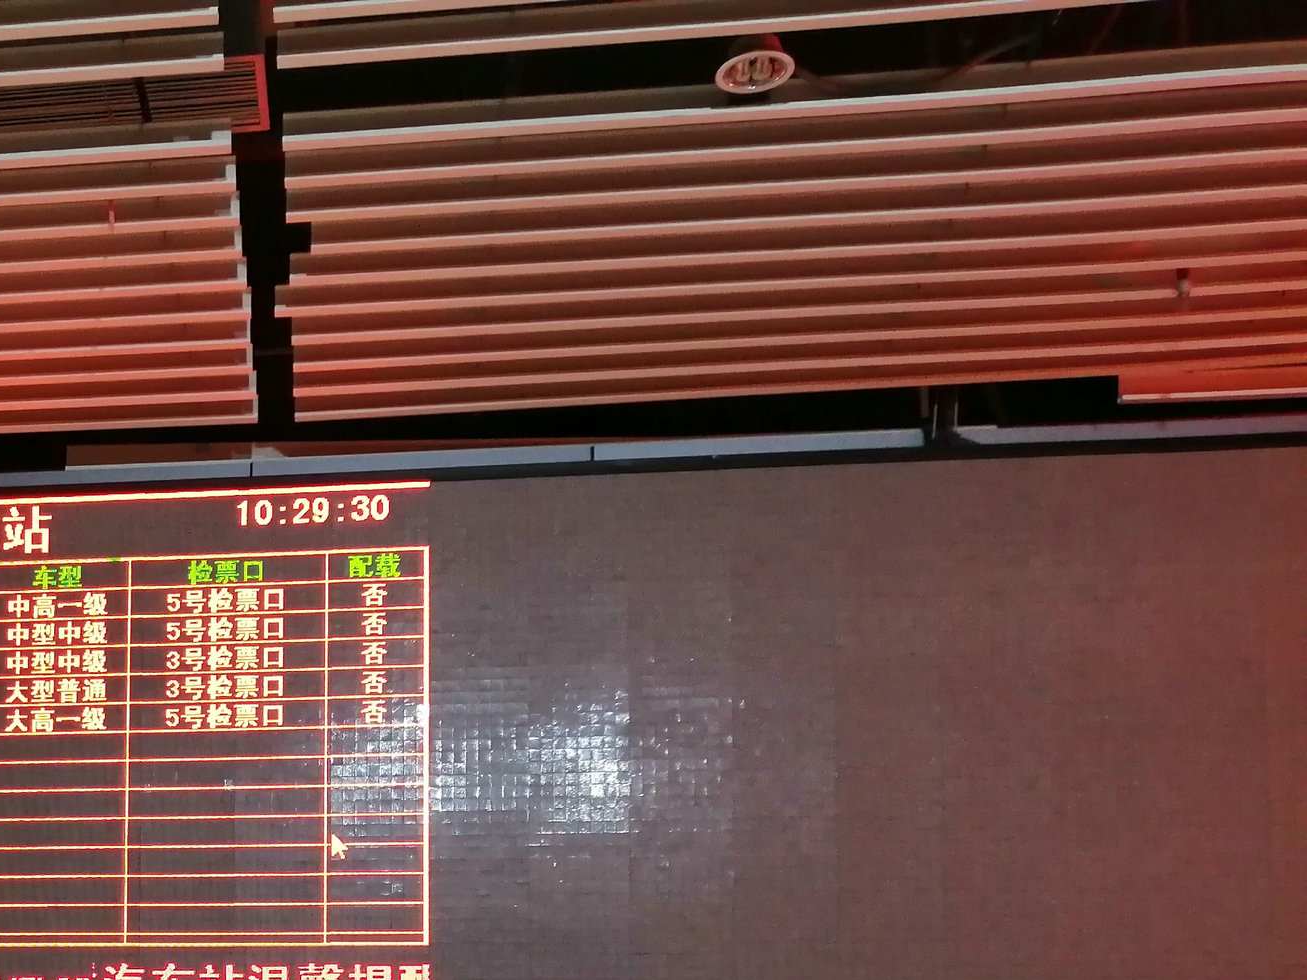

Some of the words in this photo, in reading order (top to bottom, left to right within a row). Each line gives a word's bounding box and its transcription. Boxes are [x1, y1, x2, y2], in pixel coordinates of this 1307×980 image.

[237, 495, 390, 526] 10:29:30
[34, 566, 82, 589] 车型
[188, 560, 264, 585] 检票口
[348, 553, 401, 579] 配载
[8, 592, 107, 618] 中高一级
[167, 588, 284, 614] 5号检票口
[362, 584, 387, 607] 否
[8, 621, 107, 646] 中型中级
[166, 617, 284, 642] 5号检票口
[361, 613, 387, 636] 否
[8, 650, 107, 674] 中型中级
[166, 646, 284, 671] 3号检票口
[361, 642, 387, 665] 否
[6, 679, 107, 704] 大型普通
[166, 675, 284, 701] 3号检票口
[361, 671, 387, 694] 否
[5, 707, 106, 733] 大高一级
[165, 704, 284, 729] 5号检票口
[361, 700, 387, 724] 否
